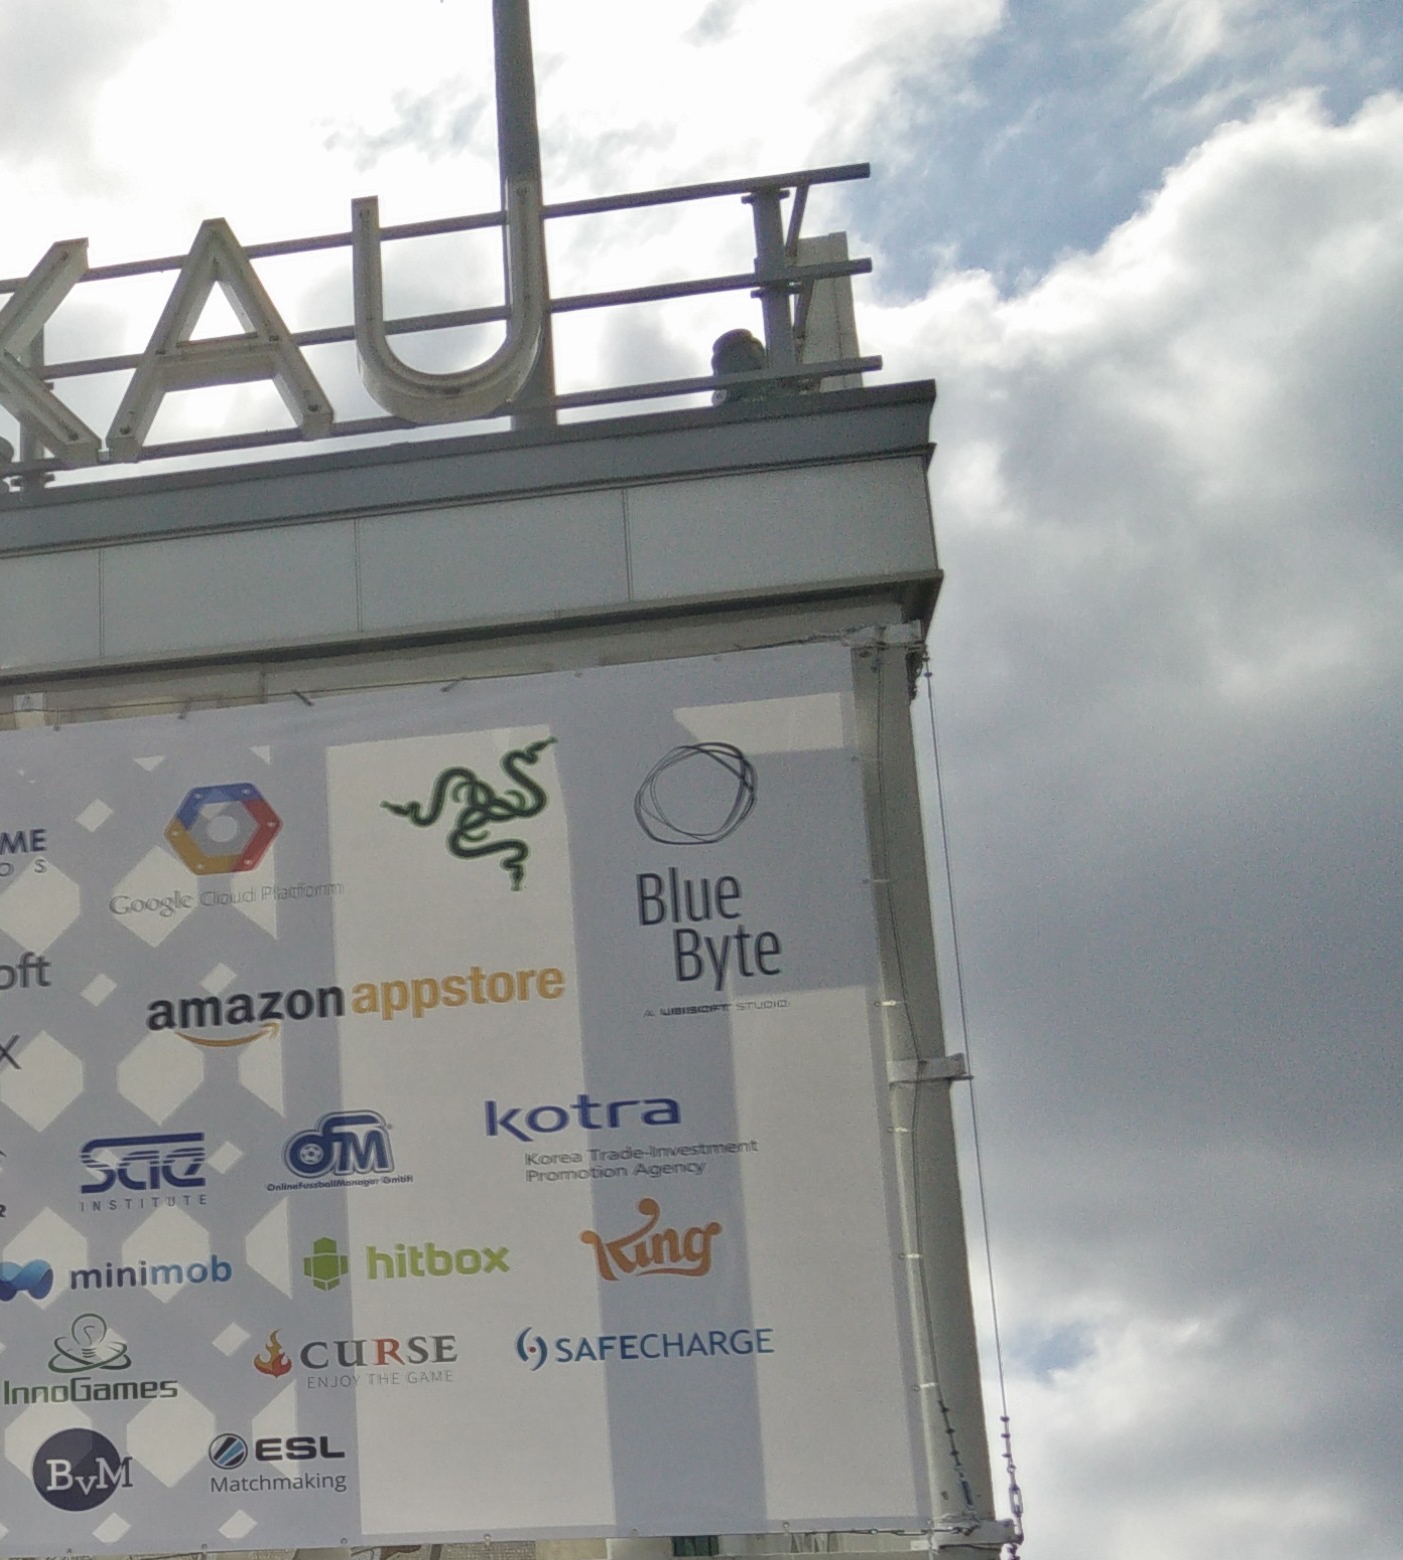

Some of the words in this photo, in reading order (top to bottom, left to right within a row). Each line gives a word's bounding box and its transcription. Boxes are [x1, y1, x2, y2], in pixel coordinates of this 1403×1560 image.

[109, 890, 193, 918] Google
[199, 885, 257, 907] Cloud
[261, 881, 344, 901] Platform
[636, 867, 742, 926] Blue
[673, 924, 782, 992] Byte
[145, 982, 345, 1031] amazon
[350, 966, 566, 1021] appstore
[736, 999, 790, 1011] STUDIO
[484, 1093, 682, 1143] kotra
[524, 1151, 583, 1166] Korea
[525, 1165, 628, 1182] Promotion
[633, 1161, 707, 1179] Agency
[79, 1194, 208, 1212] INSTITUTE
[579, 1198, 723, 1281] King
[70, 1254, 233, 1290] minimob
[365, 1242, 511, 1280] hitbox
[300, 1335, 459, 1369] CURSE
[555, 1328, 775, 1363] SAFECHARGE
[3, 1377, 179, 1405] InnoGames
[306, 1375, 360, 1389] ENJOY
[368, 1372, 401, 1385] THE
[407, 1370, 454, 1384] GAME
[255, 1436, 346, 1462] ESL
[45, 1456, 134, 1496] BvM
[209, 1472, 348, 1493] Matchmaking
